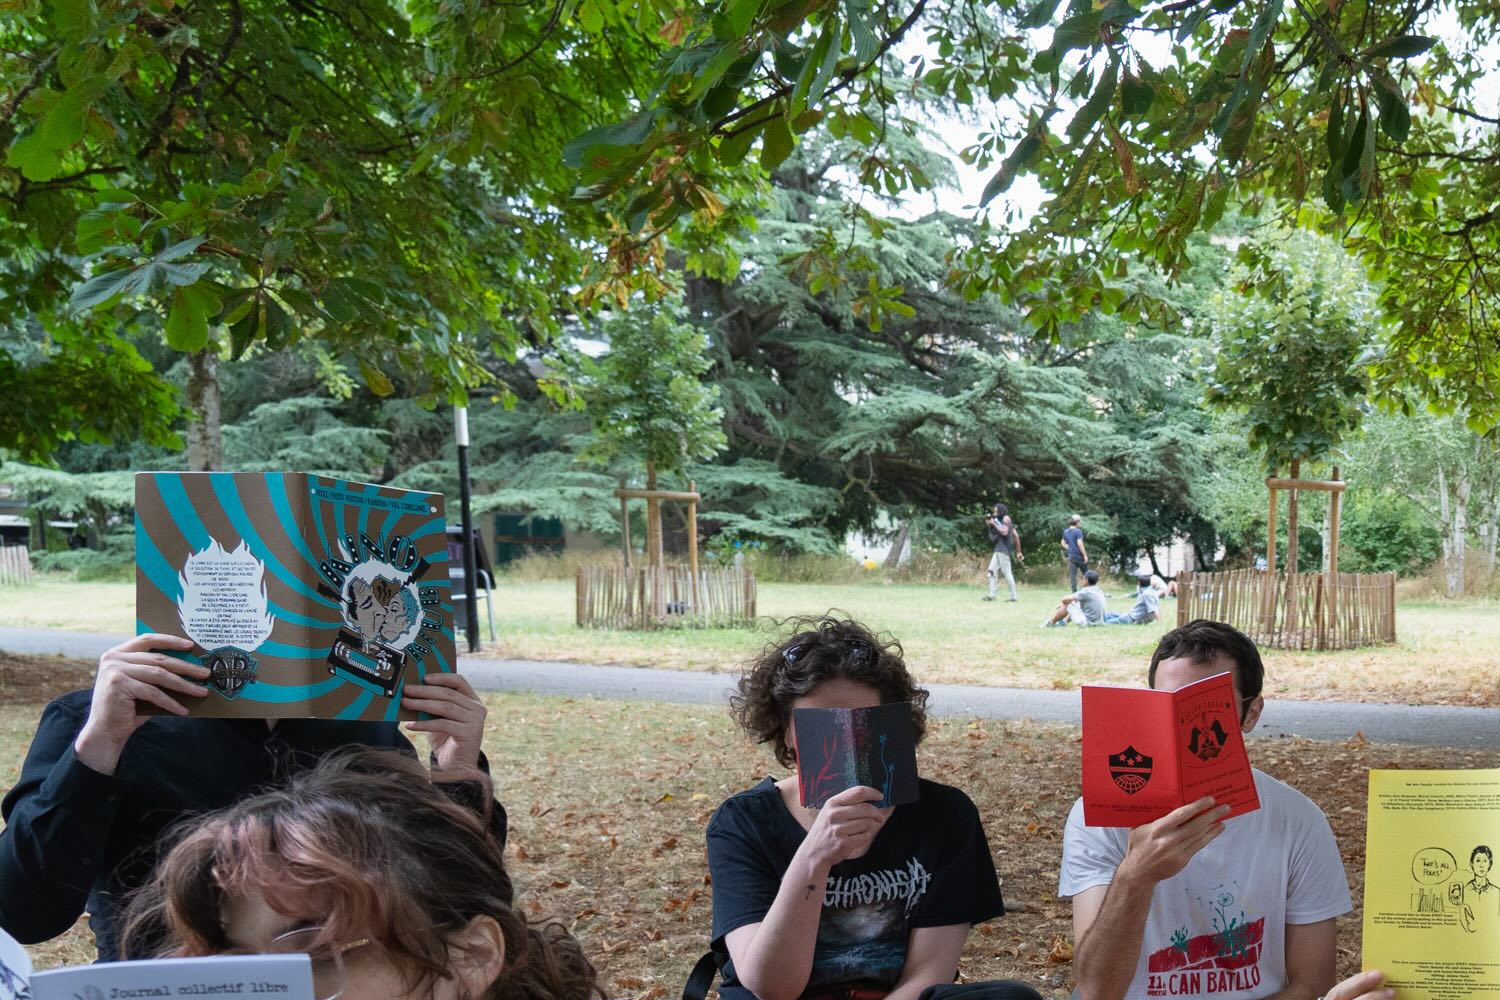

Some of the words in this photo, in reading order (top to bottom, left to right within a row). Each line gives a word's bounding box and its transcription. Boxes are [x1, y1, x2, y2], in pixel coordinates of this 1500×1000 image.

[824, 857, 933, 919] CHRONISM
[109, 986, 171, 999] Journal
[177, 983, 245, 996] collectif
[251, 982, 289, 994] libre
[1169, 972, 1200, 995] CAN
